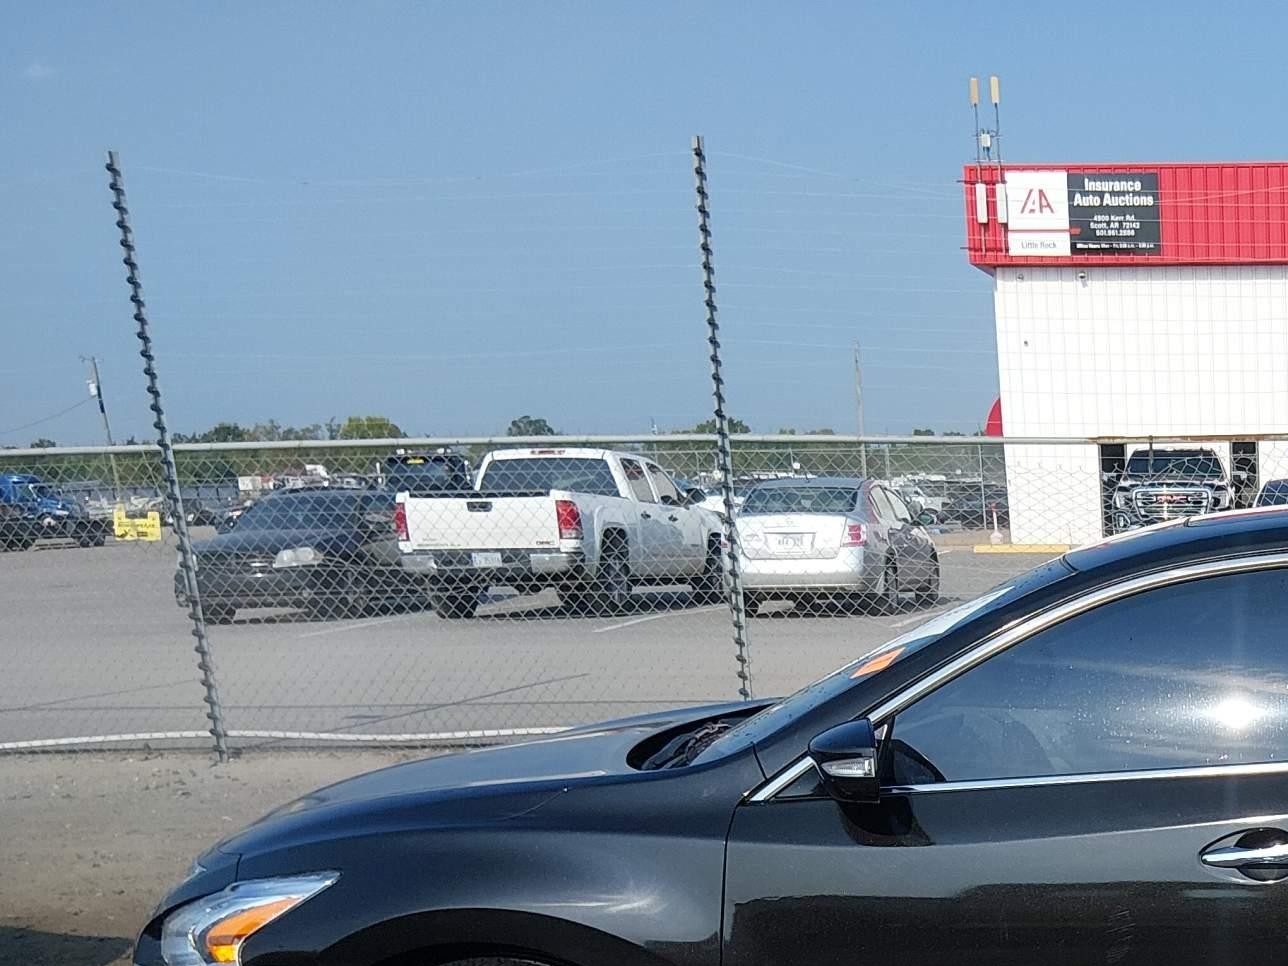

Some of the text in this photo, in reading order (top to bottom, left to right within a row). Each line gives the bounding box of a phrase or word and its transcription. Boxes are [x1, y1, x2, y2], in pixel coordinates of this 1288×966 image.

[1084, 177, 1142, 192] Insurance
[1073, 192, 1154, 206] Auto Auctions
[1021, 240, 1057, 249] Little Rock
